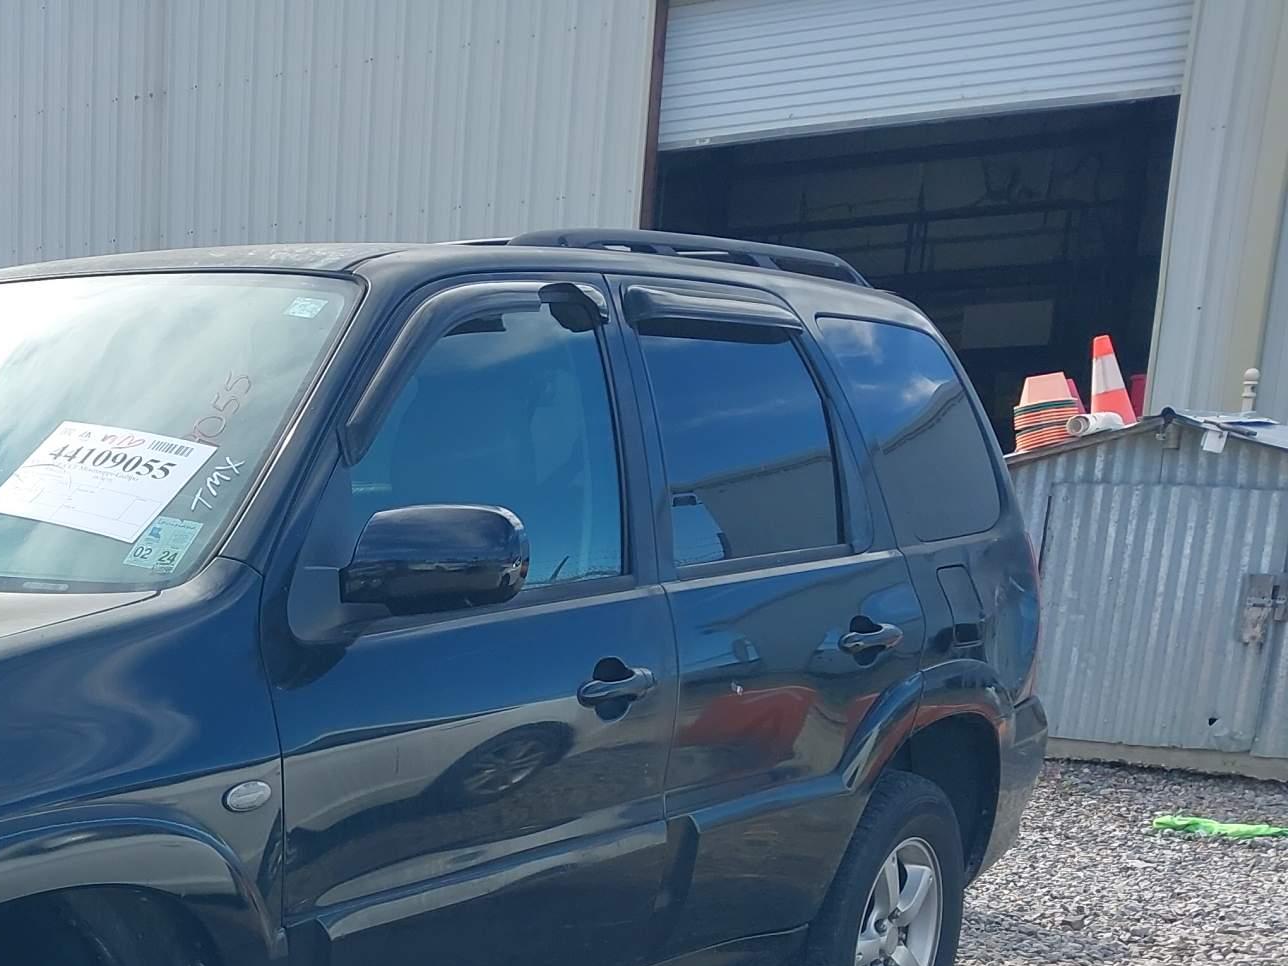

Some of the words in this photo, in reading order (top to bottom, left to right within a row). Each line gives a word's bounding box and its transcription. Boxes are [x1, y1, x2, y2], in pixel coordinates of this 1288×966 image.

[48, 443, 177, 480] 44109055
[190, 456, 246, 513] TMX
[133, 546, 153, 560] 02
[157, 550, 179, 564] 24
